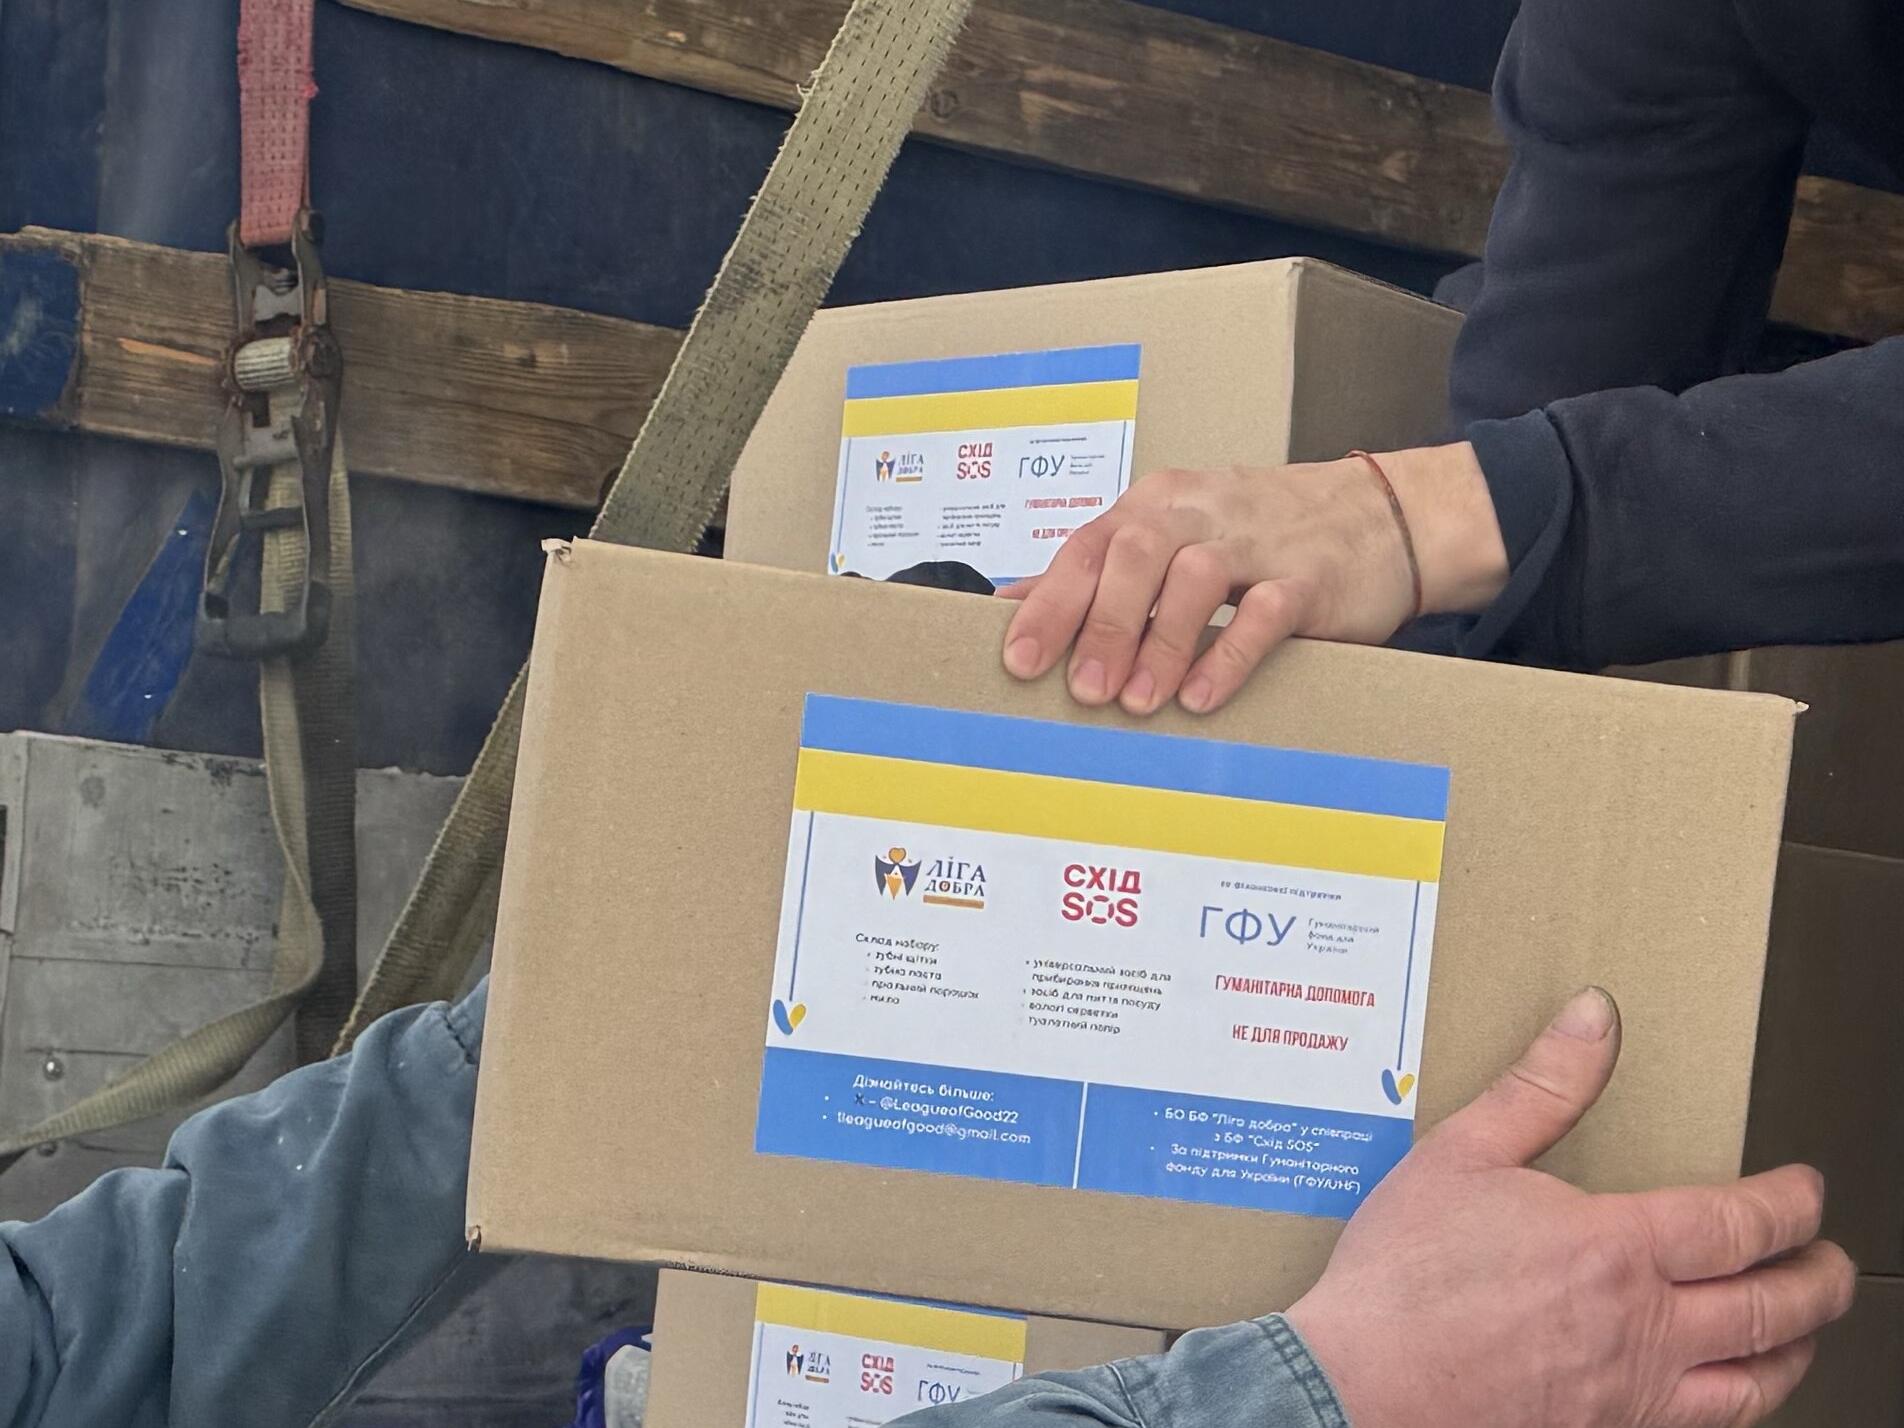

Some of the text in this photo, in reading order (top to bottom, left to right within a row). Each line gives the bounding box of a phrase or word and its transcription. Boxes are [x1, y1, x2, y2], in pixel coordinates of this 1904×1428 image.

[958, 442, 993, 459] СХІД
[956, 460, 992, 480] SOS
[1018, 454, 1066, 479] ГФУ
[926, 856, 987, 883] ЛІГА
[1063, 864, 1141, 894] СХІД
[924, 879, 985, 897] ДОБРА
[1061, 892, 1138, 927] SOS
[1199, 905, 1297, 946] ГФУ
[1215, 974, 1376, 1008] ГУМАНІТАРНА ДОПОМОГА
[1232, 1024, 1349, 1052] НЕ ДЛЯ ПРОДАЖУ
[1164, 1107, 1185, 1121] БО
[1188, 1109, 1209, 1122] БФ
[1171, 1142, 1187, 1156] За
